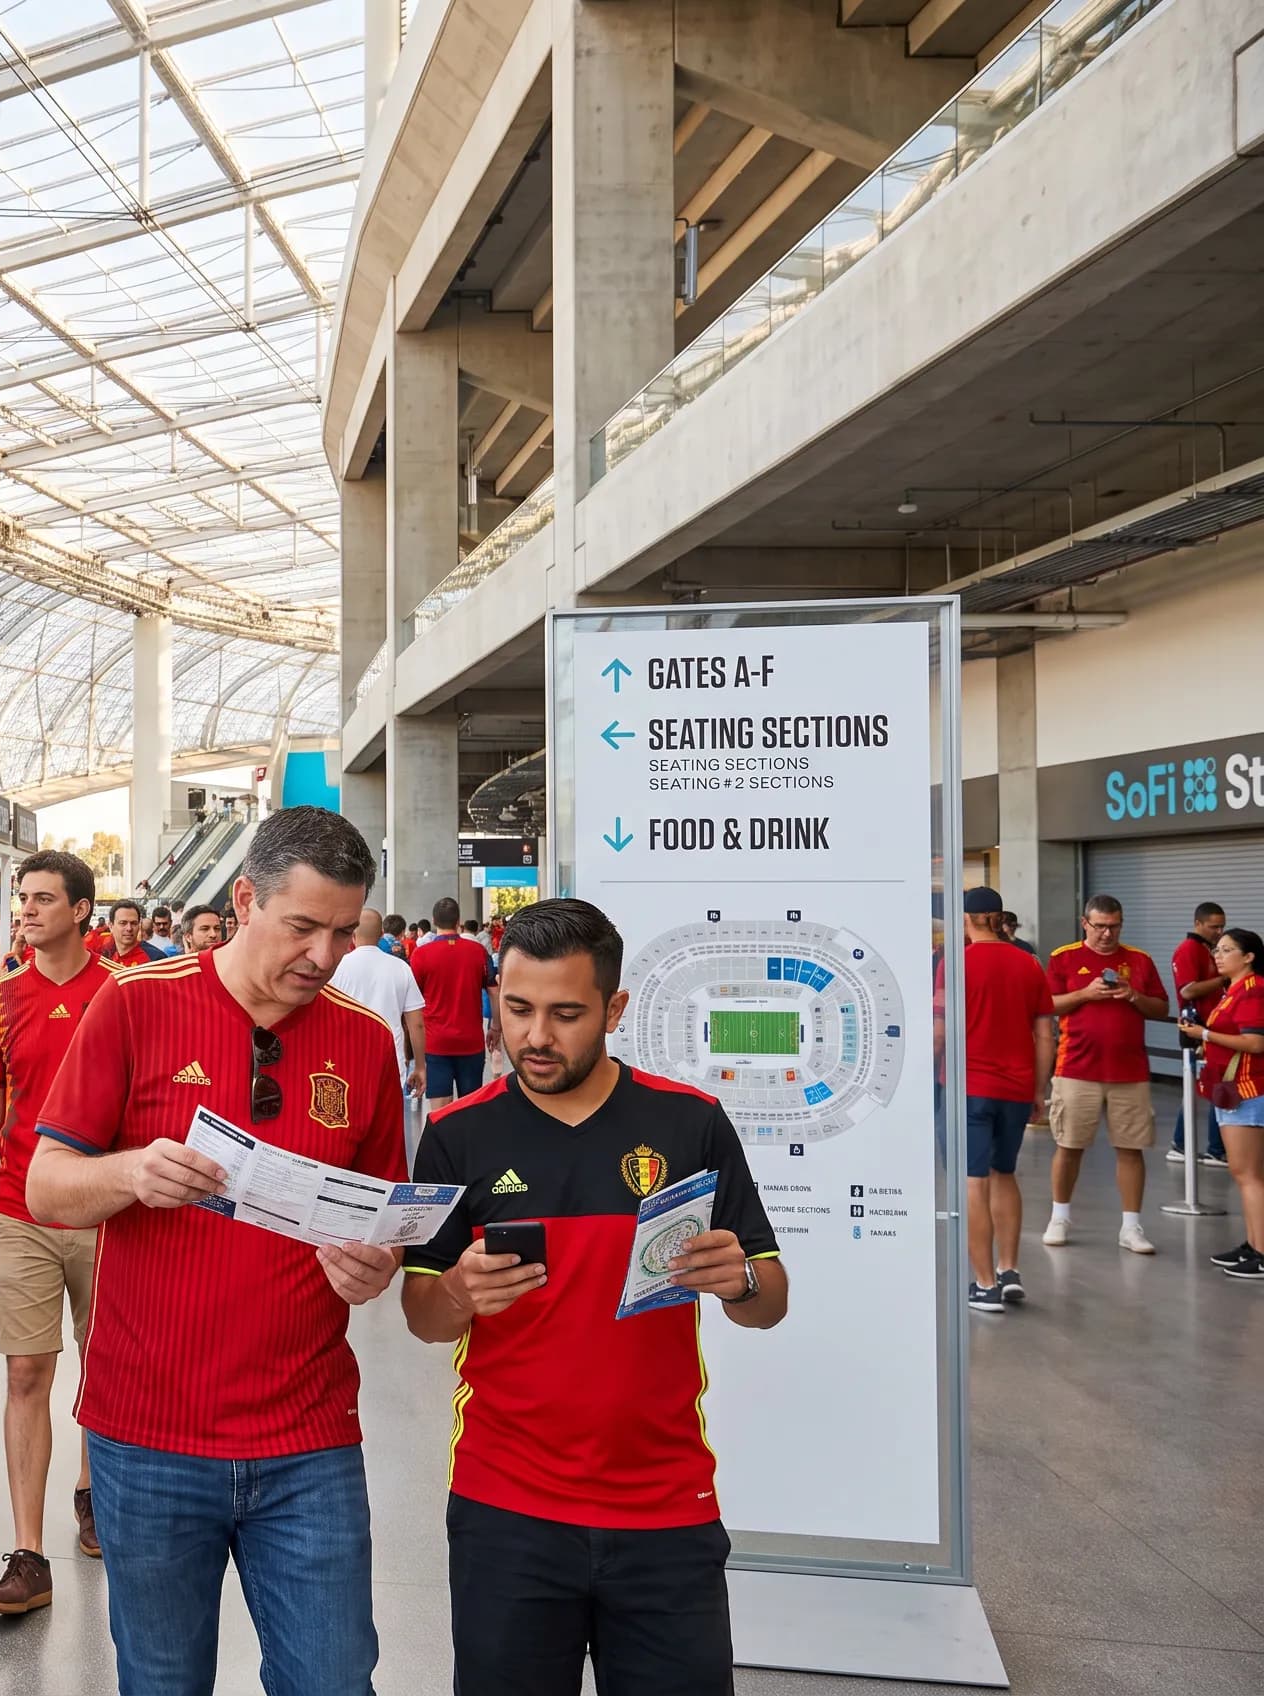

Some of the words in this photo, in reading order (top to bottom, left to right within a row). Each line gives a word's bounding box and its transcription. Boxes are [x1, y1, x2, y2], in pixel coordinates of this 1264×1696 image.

[648, 655, 726, 690] GATES
[734, 654, 775, 689] A-F
[648, 717, 754, 751] SEATING
[761, 714, 889, 749] SECTIONS
[649, 758, 720, 772] SEATING
[724, 757, 809, 771] SECTIONS
[649, 777, 720, 791] SEATING
[749, 775, 834, 789] SECTIONS
[1105, 762, 1176, 822] SoFi
[1225, 753, 1264, 810] St
[649, 817, 715, 850] FOOD
[723, 818, 743, 850] &
[749, 816, 830, 850] DRINK
[172, 1074, 212, 1087] adidas
[491, 1183, 529, 1195] adidas
